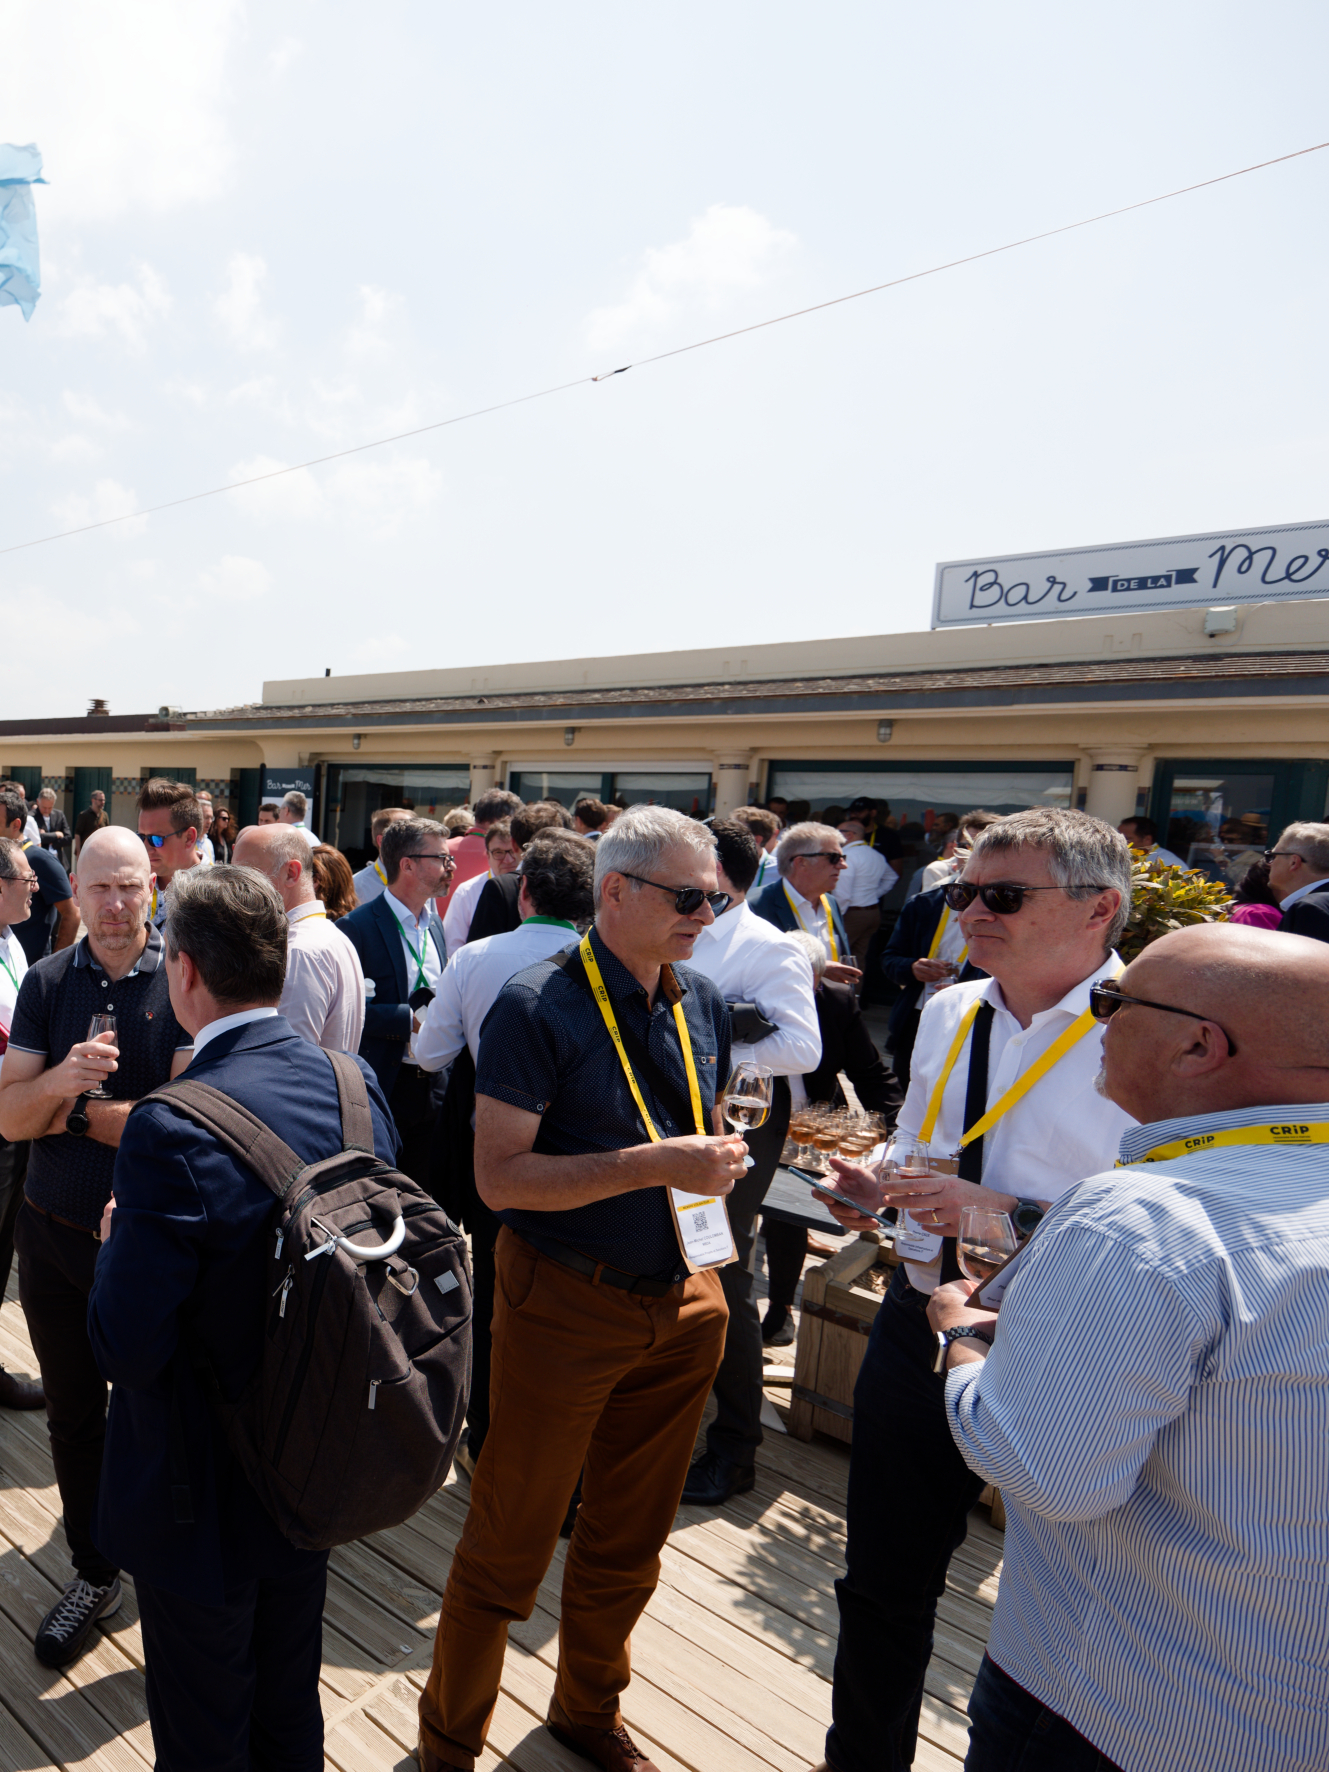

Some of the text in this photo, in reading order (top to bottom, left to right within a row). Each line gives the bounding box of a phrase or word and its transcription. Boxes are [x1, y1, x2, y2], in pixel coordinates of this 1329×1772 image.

[964, 568, 1078, 610] Bar
[1117, 578, 1139, 590] DE
[1147, 575, 1168, 588] LA
